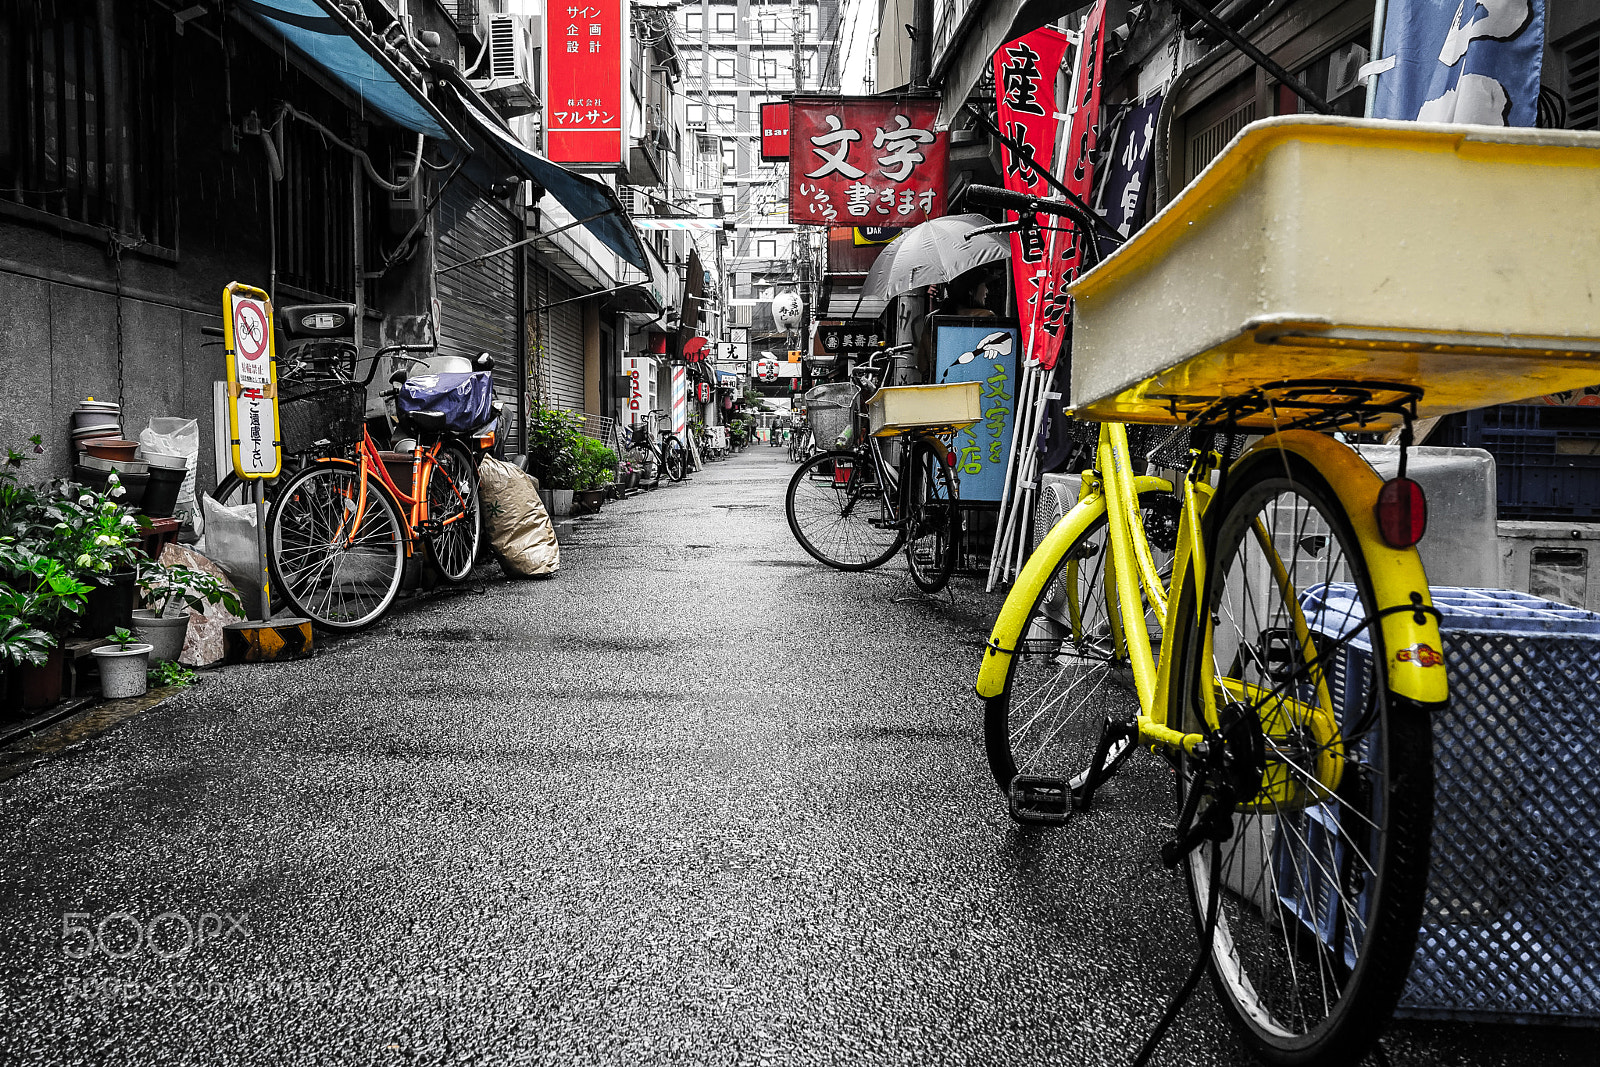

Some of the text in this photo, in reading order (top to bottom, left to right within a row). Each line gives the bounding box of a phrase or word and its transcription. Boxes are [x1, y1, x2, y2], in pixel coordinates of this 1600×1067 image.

[566, 7, 601, 19] サイン
[566, 24, 602, 36] 企画
[566, 41, 602, 53] 設計
[567, 98, 602, 107] 株式会社
[553, 110, 615, 125] マルサン
[764, 128, 789, 137] Bar
[803, 114, 936, 183] 文字
[844, 181, 936, 217] 書きます
[726, 344, 738, 359] 光
[984, 363, 1013, 464] 文字を
